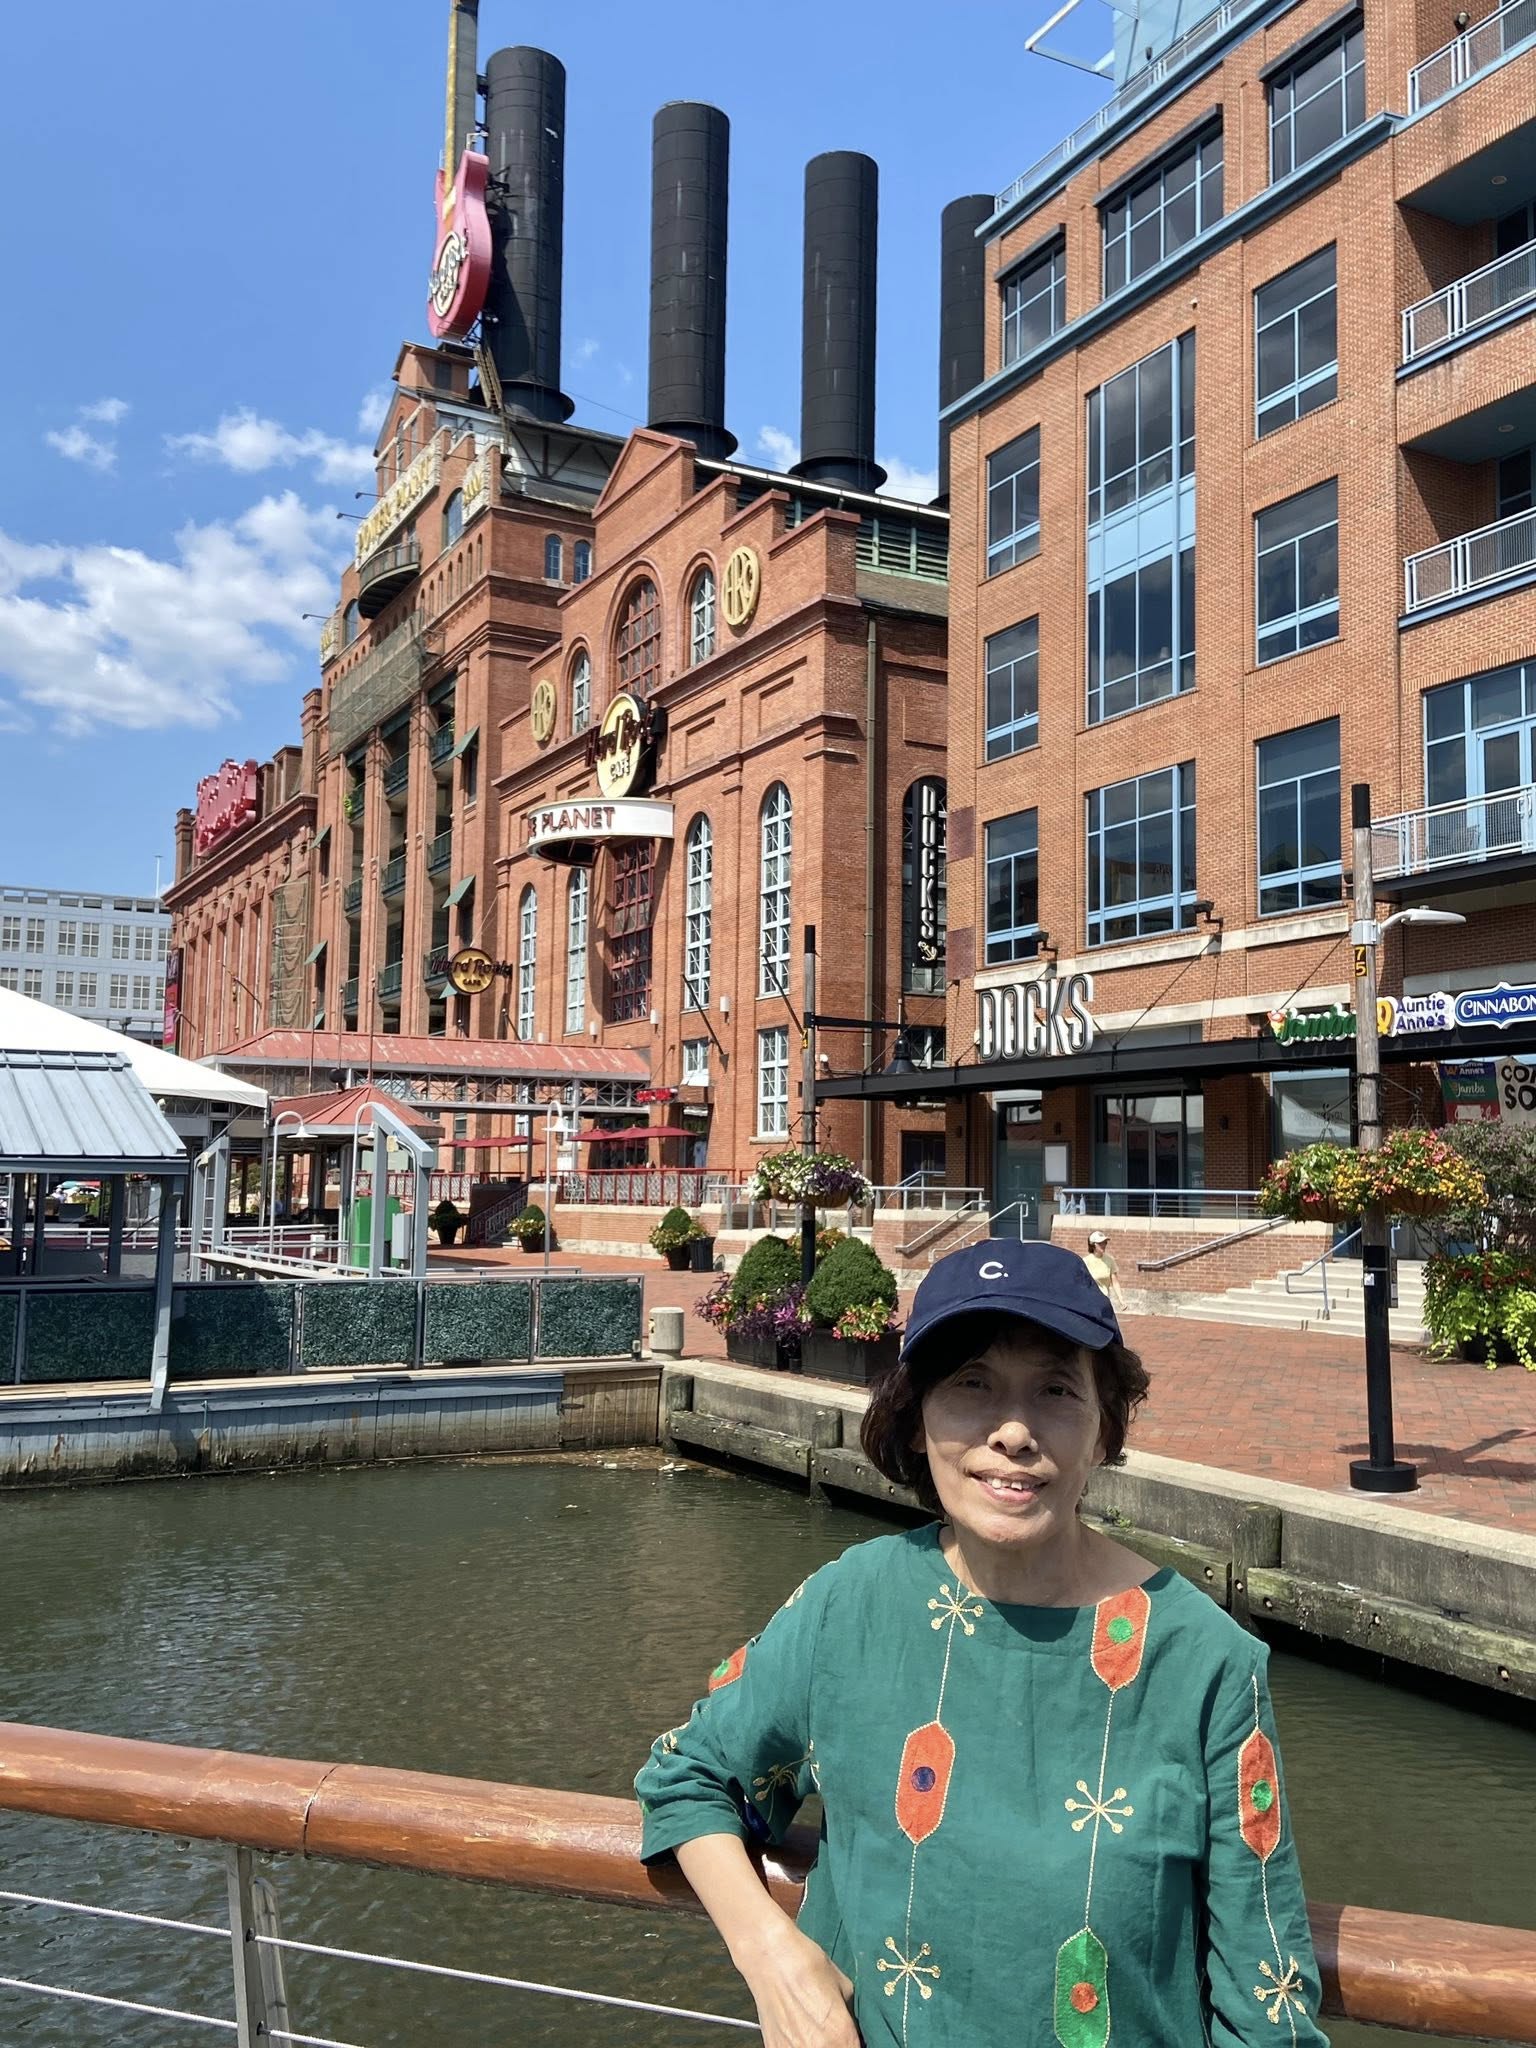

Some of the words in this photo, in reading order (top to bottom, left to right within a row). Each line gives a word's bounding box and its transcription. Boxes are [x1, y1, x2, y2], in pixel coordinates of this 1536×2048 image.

[542, 806, 616, 834] PLANET
[920, 785, 936, 940] DOCKS
[979, 973, 1094, 1063] DOCKS
[1396, 994, 1446, 1014] Auntie
[1396, 1012, 1447, 1030] Anne's
